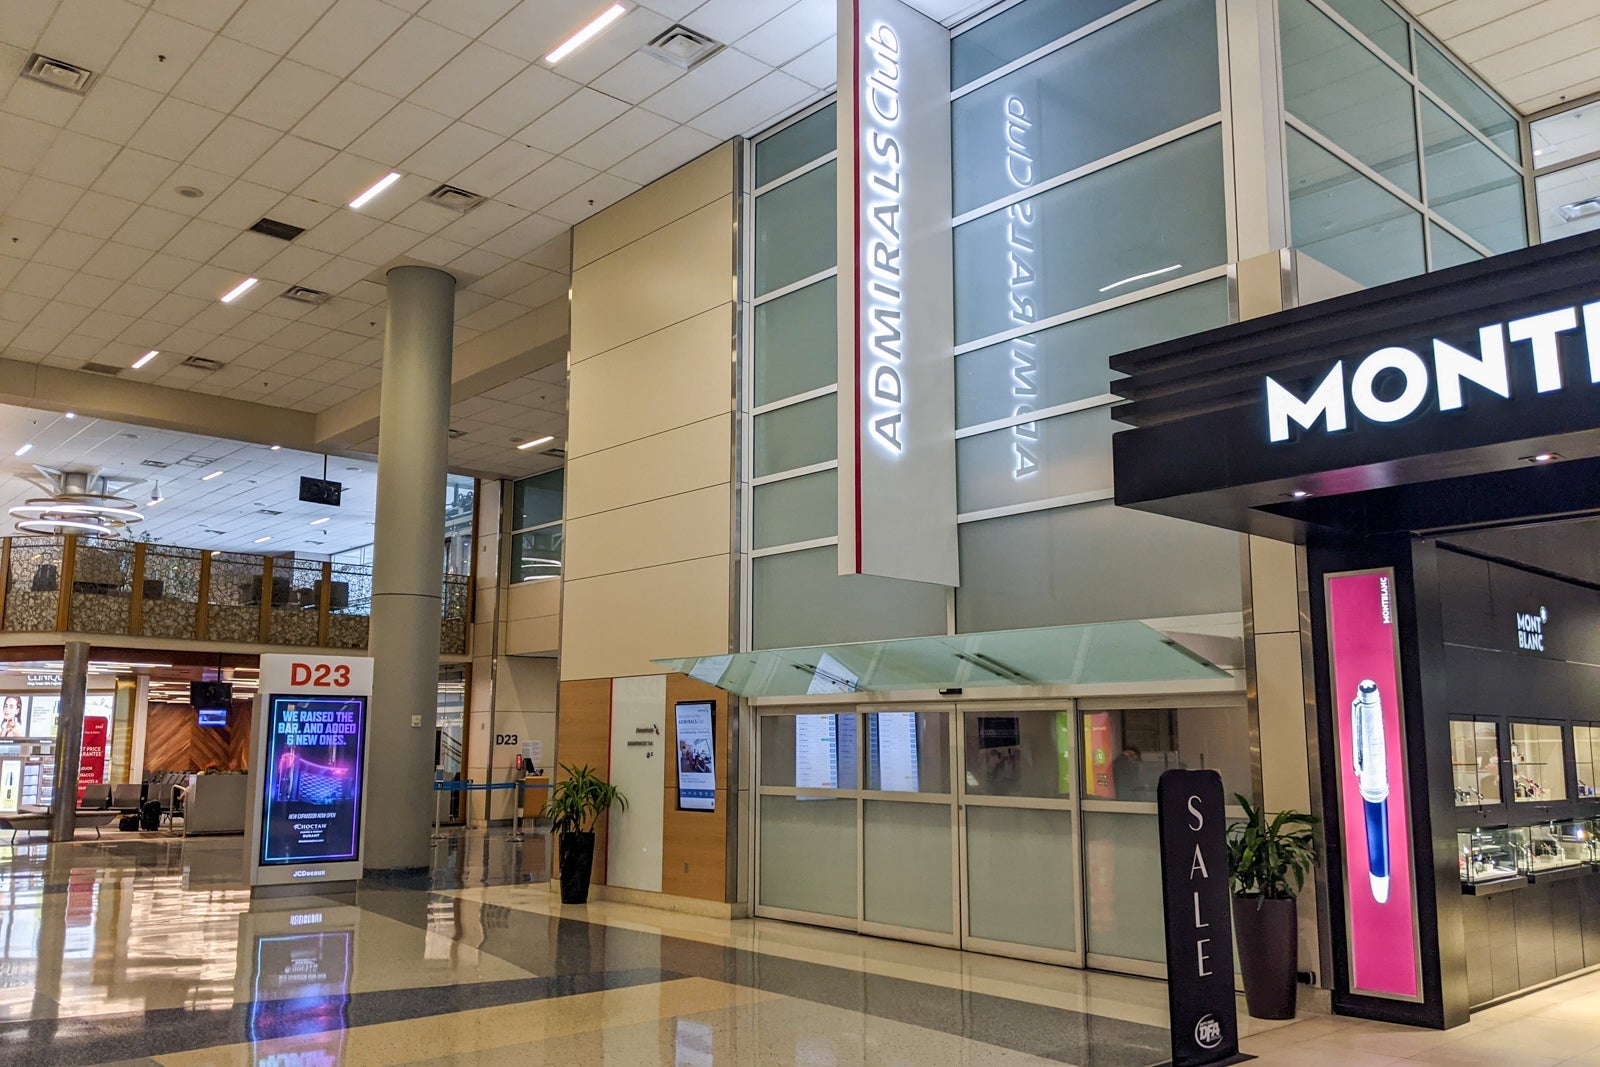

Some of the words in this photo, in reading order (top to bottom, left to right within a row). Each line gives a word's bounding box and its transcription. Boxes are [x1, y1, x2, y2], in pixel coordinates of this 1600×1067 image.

[869, 23, 900, 122] Club
[872, 130, 903, 454] ADMIRALS
[1380, 576, 1390, 624] MONTBLANC
[1516, 612, 1542, 633] MONT
[1518, 631, 1544, 652] BLANC
[27, 674, 63, 682] CLINIQ
[290, 662, 351, 687] D23
[283, 711, 299, 722] WE
[300, 711, 334, 722] RAISED
[336, 711, 354, 722] THE
[278, 722, 301, 734] BAR.
[303, 723, 324, 734] AND
[325, 723, 357, 734] ADDED
[286, 734, 294, 746] 6
[296, 735, 318, 746] NEW
[319, 735, 347, 746] ONES.
[496, 734, 518, 746] D23
[1187, 794, 1213, 978] SALE
[1199, 1021, 1220, 1042] DFA
